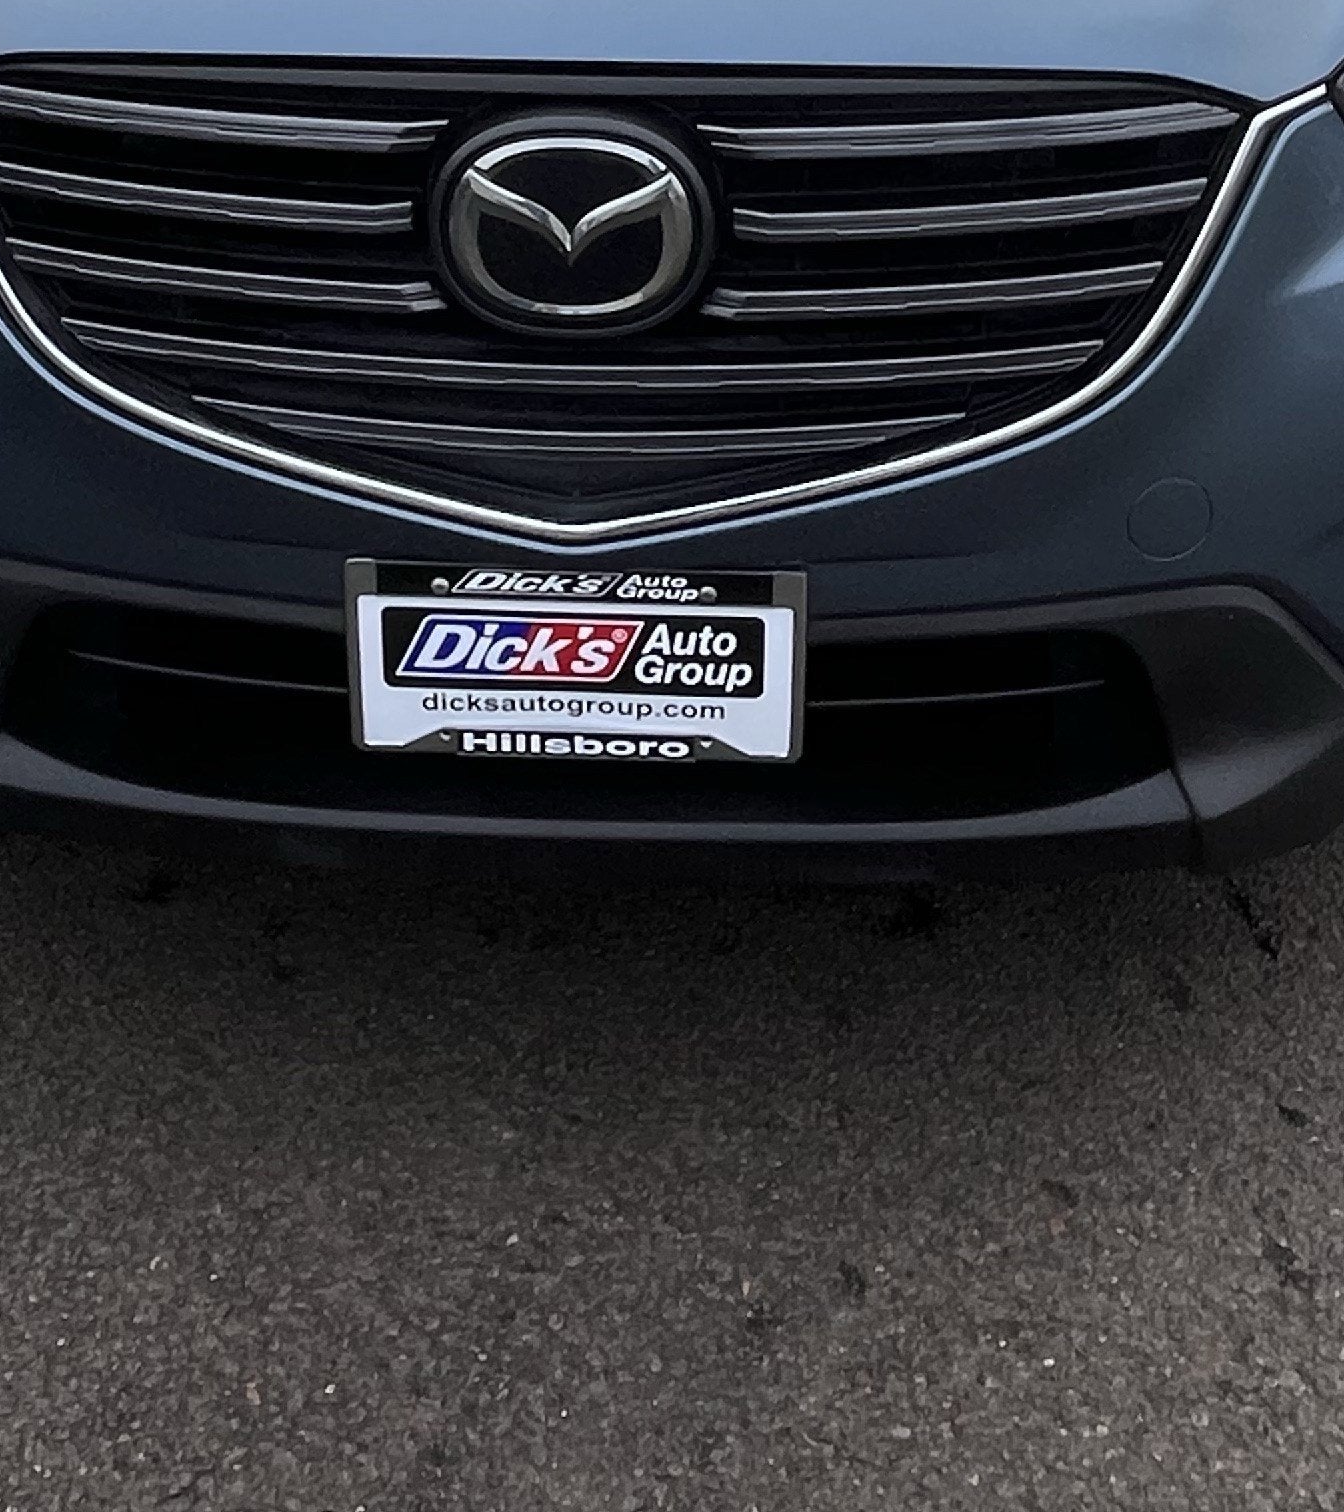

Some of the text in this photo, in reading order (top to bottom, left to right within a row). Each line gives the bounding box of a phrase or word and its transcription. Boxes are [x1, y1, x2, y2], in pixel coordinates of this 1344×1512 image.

[464, 572, 688, 593] Dick's Auto
[616, 586, 698, 602] Group
[412, 622, 738, 675] Dick's Auto
[634, 655, 753, 693] Group
[422, 693, 726, 720] dicksautogroup.com
[462, 732, 690, 758] Hillsboro
